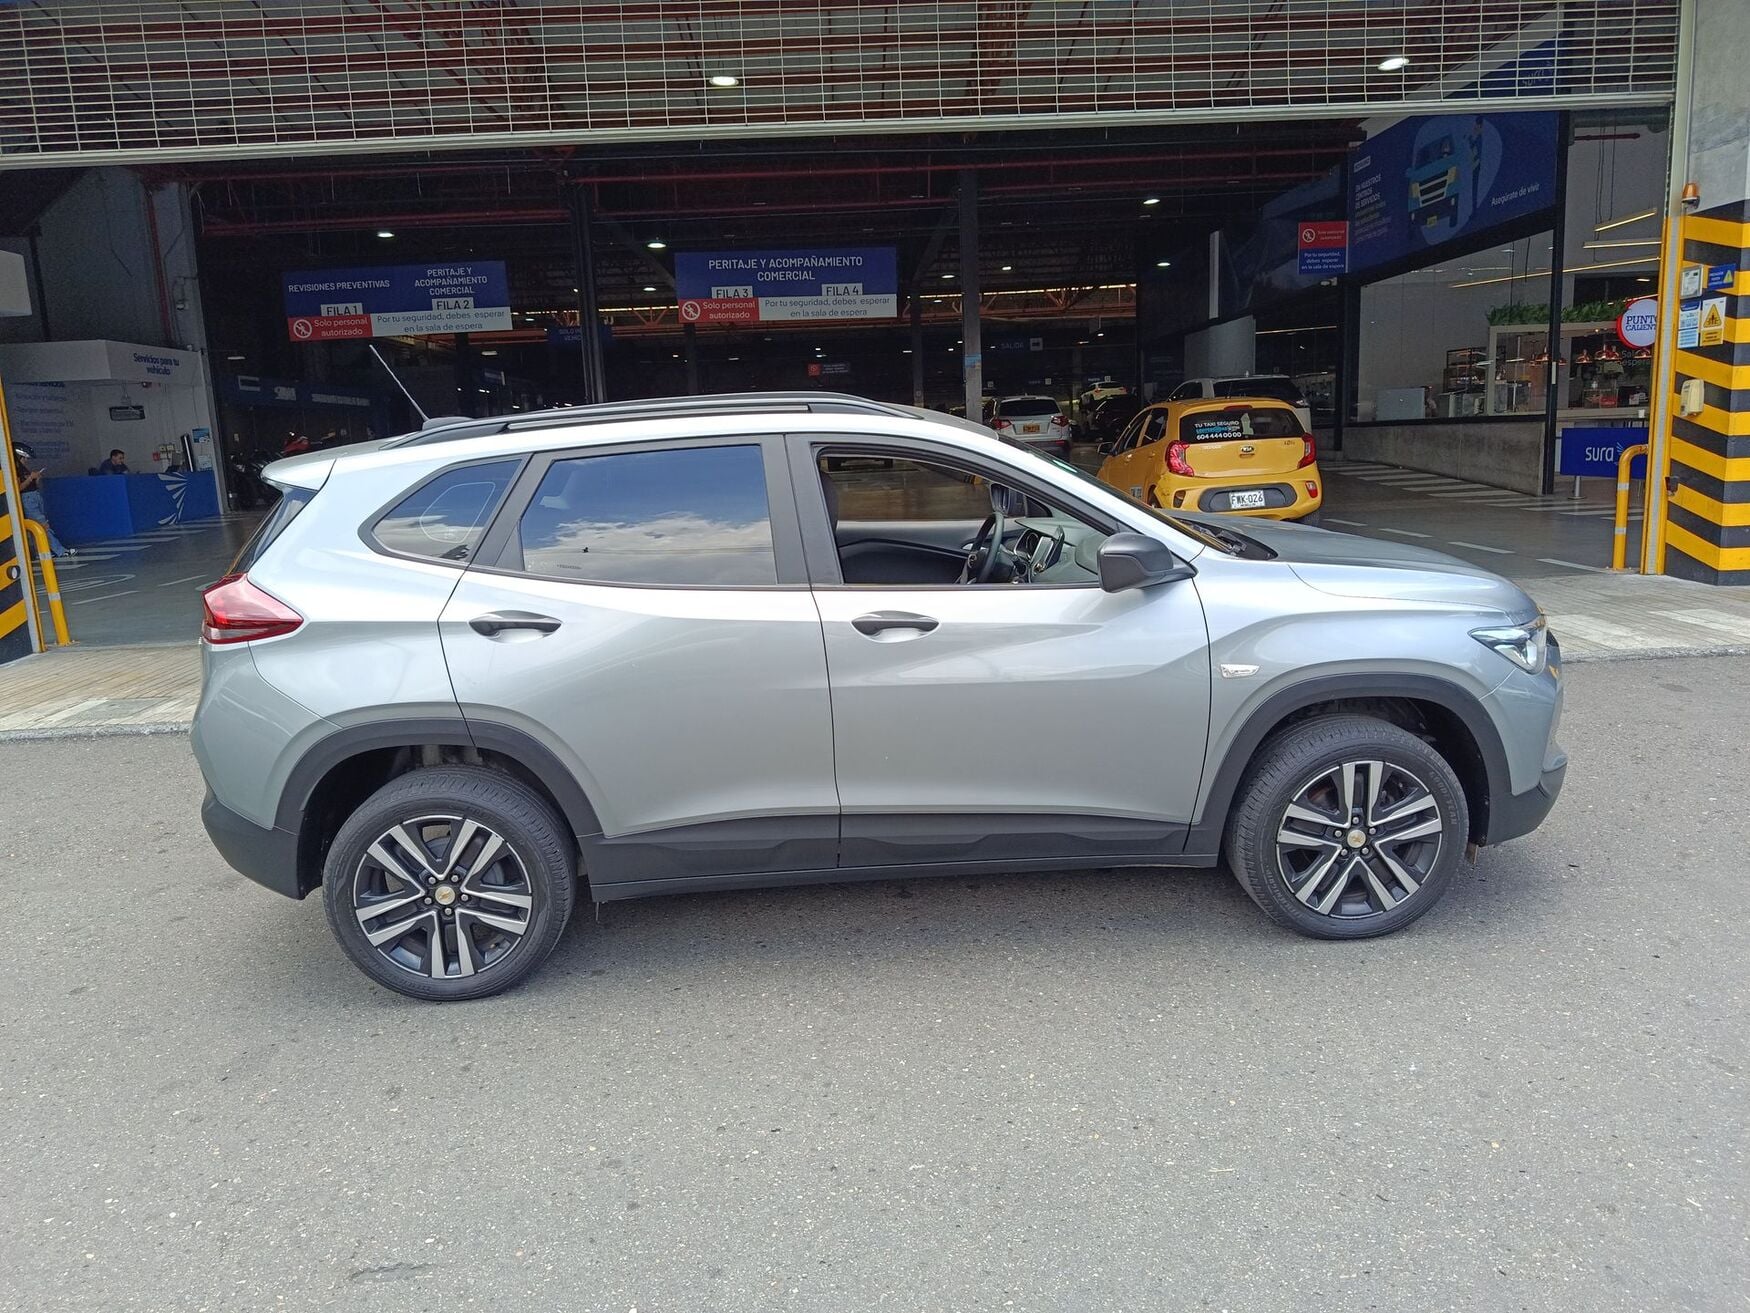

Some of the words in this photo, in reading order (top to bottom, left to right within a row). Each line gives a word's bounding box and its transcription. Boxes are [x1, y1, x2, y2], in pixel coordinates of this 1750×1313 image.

[1519, 185, 1526, 197] de
[708, 259, 758, 270] PERITAJE
[760, 258, 767, 268] Y
[768, 255, 863, 268] ACOMPAÑAMIENTO
[427, 267, 466, 277] PERITAJE
[466, 267, 472, 275] Y
[757, 270, 816, 282] COMERCIAL
[288, 282, 336, 292] REVISIONES
[336, 279, 390, 290] PREVENTIVAS
[414, 275, 488, 287] ACOMPAÑAMIENTO
[429, 286, 475, 296] COMERCIAL
[716, 289, 740, 298] FILA
[742, 288, 749, 298] 3
[826, 286, 850, 296] FILA
[852, 286, 859, 296] 4
[436, 300, 461, 310] FILA
[462, 300, 470, 310] 2
[702, 302, 721, 310] Solo
[722, 301, 756, 311] personal
[832, 297, 857, 306] debes
[860, 297, 890, 307] esperar
[326, 306, 350, 316] FILA
[352, 305, 358, 315] 1
[709, 311, 750, 320] autorizado
[790, 310, 800, 318] en
[802, 309, 809, 317] la
[810, 309, 826, 317] sala
[828, 308, 839, 316] de
[840, 308, 868, 318] espera
[377, 315, 391, 323] Por
[392, 315, 400, 323] tu
[446, 312, 471, 320] debes
[474, 311, 505, 320] esperar
[1626, 315, 1657, 324] PUNT
[314, 319, 332, 327] Solo
[333, 318, 368, 328] personal
[404, 325, 414, 333] en
[416, 324, 423, 332] la
[425, 323, 441, 331] sala
[443, 323, 453, 331] de
[455, 322, 483, 332] espera
[321, 328, 363, 336] autorizado
[1585, 446, 1614, 461] sura
